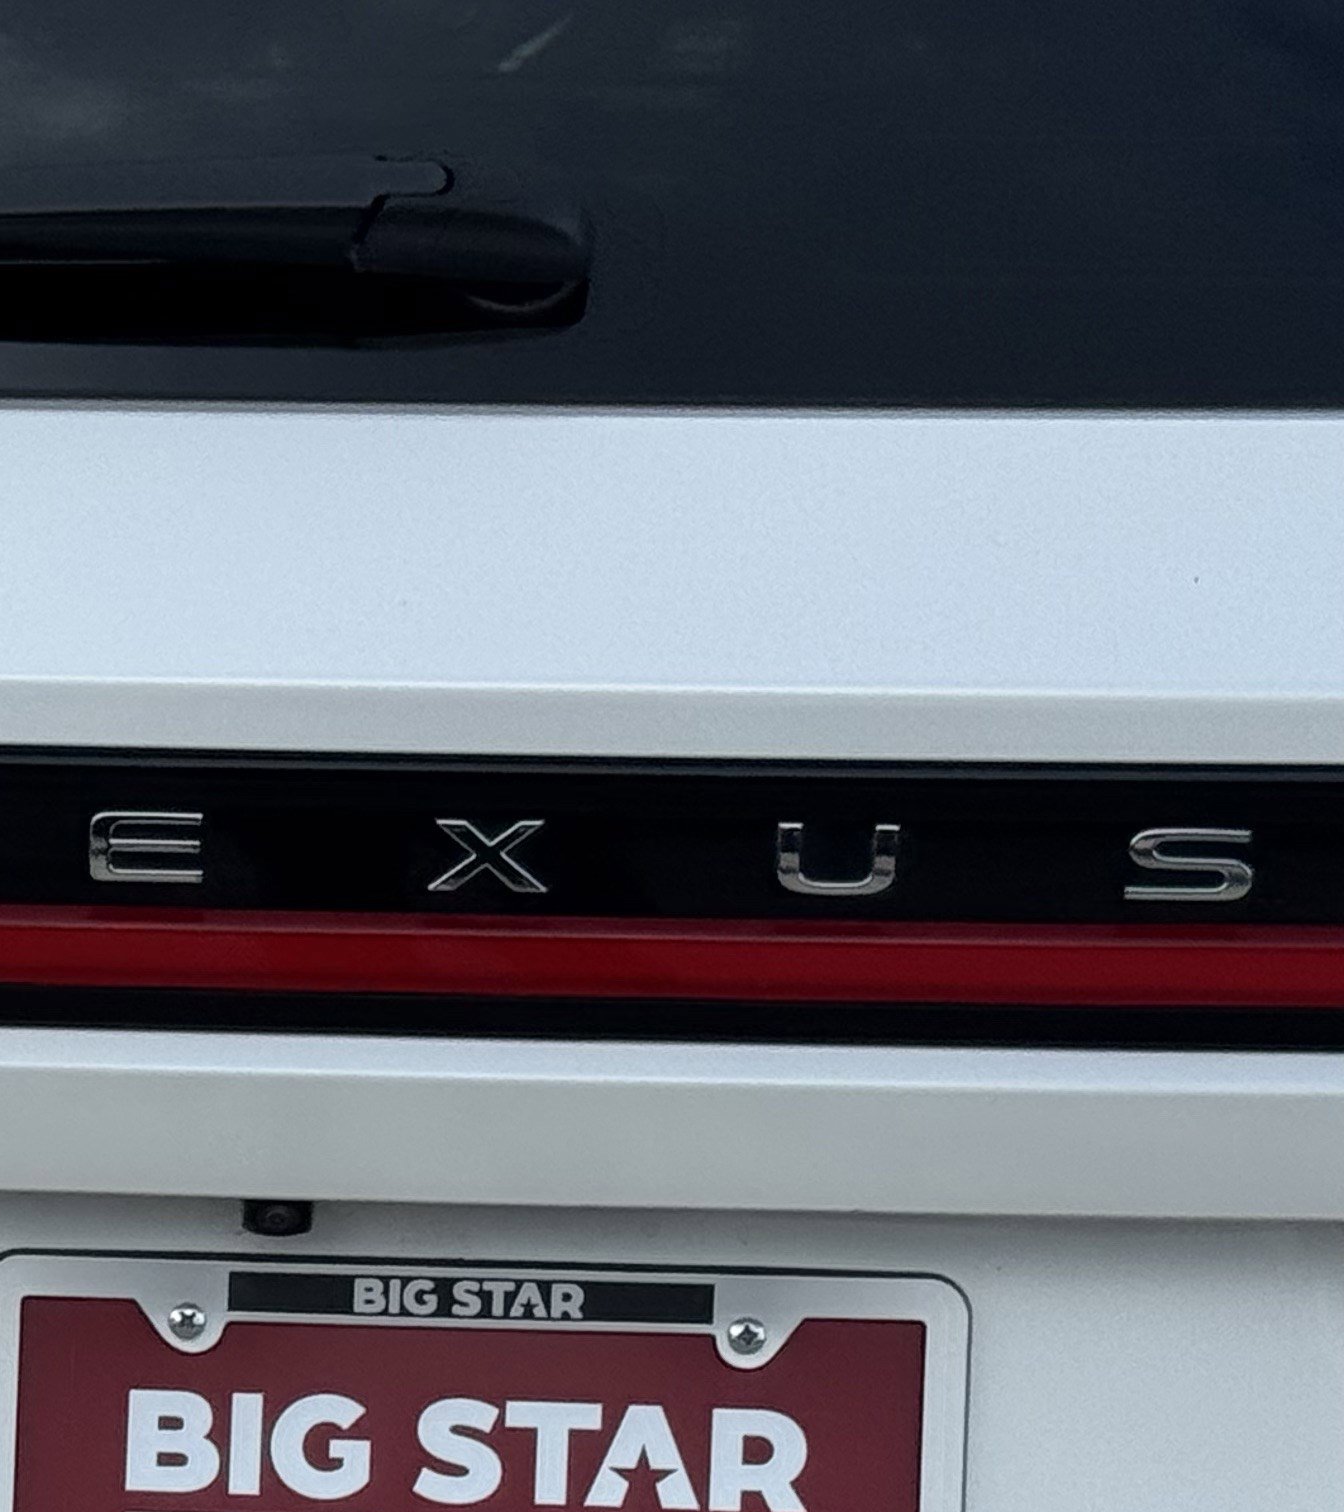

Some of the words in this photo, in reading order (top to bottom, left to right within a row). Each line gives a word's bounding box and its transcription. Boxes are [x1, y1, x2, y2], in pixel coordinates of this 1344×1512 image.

[353, 1277, 438, 1315] BIG
[451, 1280, 585, 1320] STAR
[124, 1388, 372, 1500] BIG
